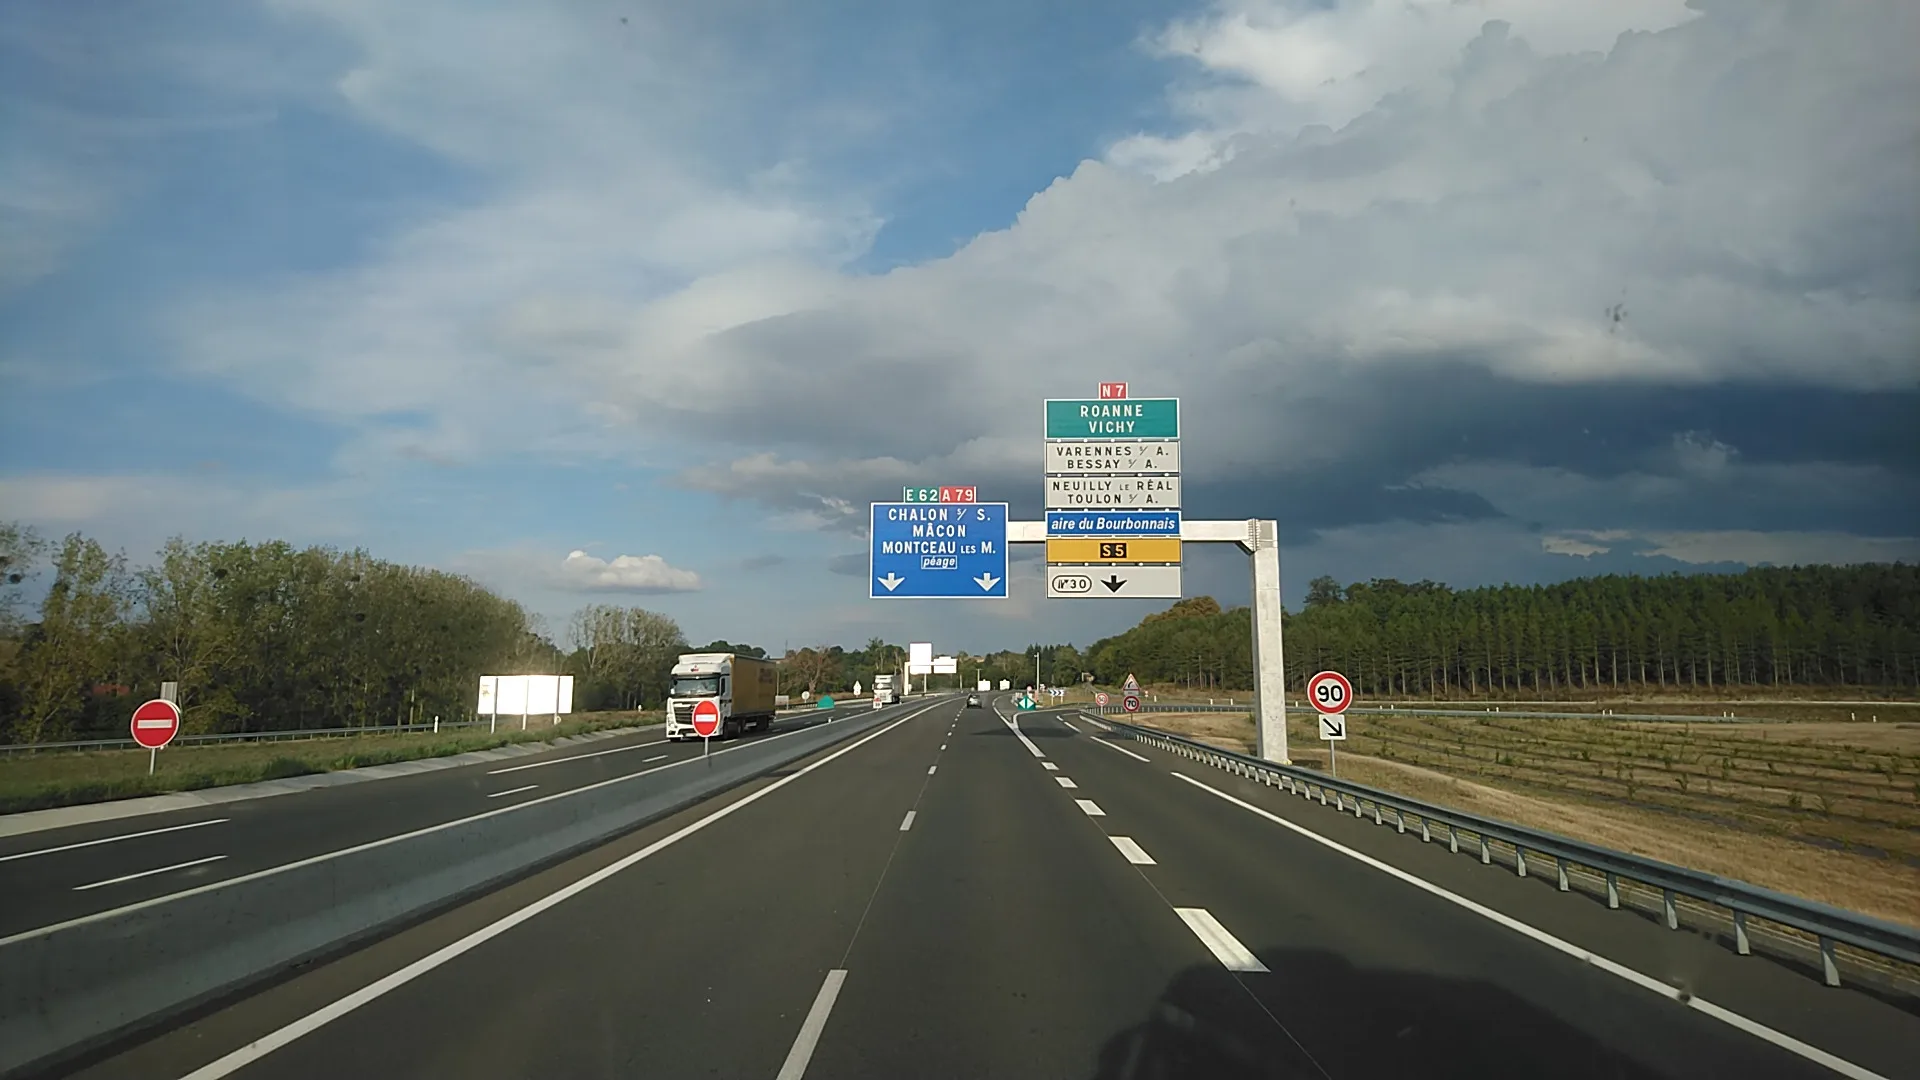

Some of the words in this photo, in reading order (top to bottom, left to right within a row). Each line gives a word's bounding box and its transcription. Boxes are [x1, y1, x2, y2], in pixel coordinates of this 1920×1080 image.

[1102, 385, 1111, 397] N
[1115, 385, 1124, 397] 7
[1080, 405, 1143, 417] ROANNE
[1089, 421, 1135, 433] VICHY
[1057, 447, 1132, 456] VARENNES
[1157, 446, 1169, 456] A.
[1068, 460, 1120, 469] BESSAY
[1145, 459, 1158, 468] A.
[1052, 481, 1112, 491] NEUILLY
[1137, 480, 1172, 490] RÉAL
[906, 490, 914, 501] E
[919, 490, 938, 501] 62
[942, 490, 950, 501] A
[956, 490, 973, 501] 79
[1068, 495, 1122, 504] TOULON
[1146, 494, 1158, 504] A.
[888, 508, 948, 520] CHALON
[977, 508, 990, 520] S.
[1052, 518, 1075, 530] aire
[1079, 517, 1093, 530] du
[1096, 517, 1175, 530] Bourbonnais
[913, 523, 966, 537] MÂCON
[882, 541, 956, 554] MONTCEAU
[960, 545, 976, 554] LES
[982, 541, 996, 554] M.
[1103, 544, 1110, 556] S
[1116, 544, 1124, 556] 5
[923, 556, 956, 568] péage
[1070, 579, 1086, 589] 30
[1318, 685, 1343, 702] 90
